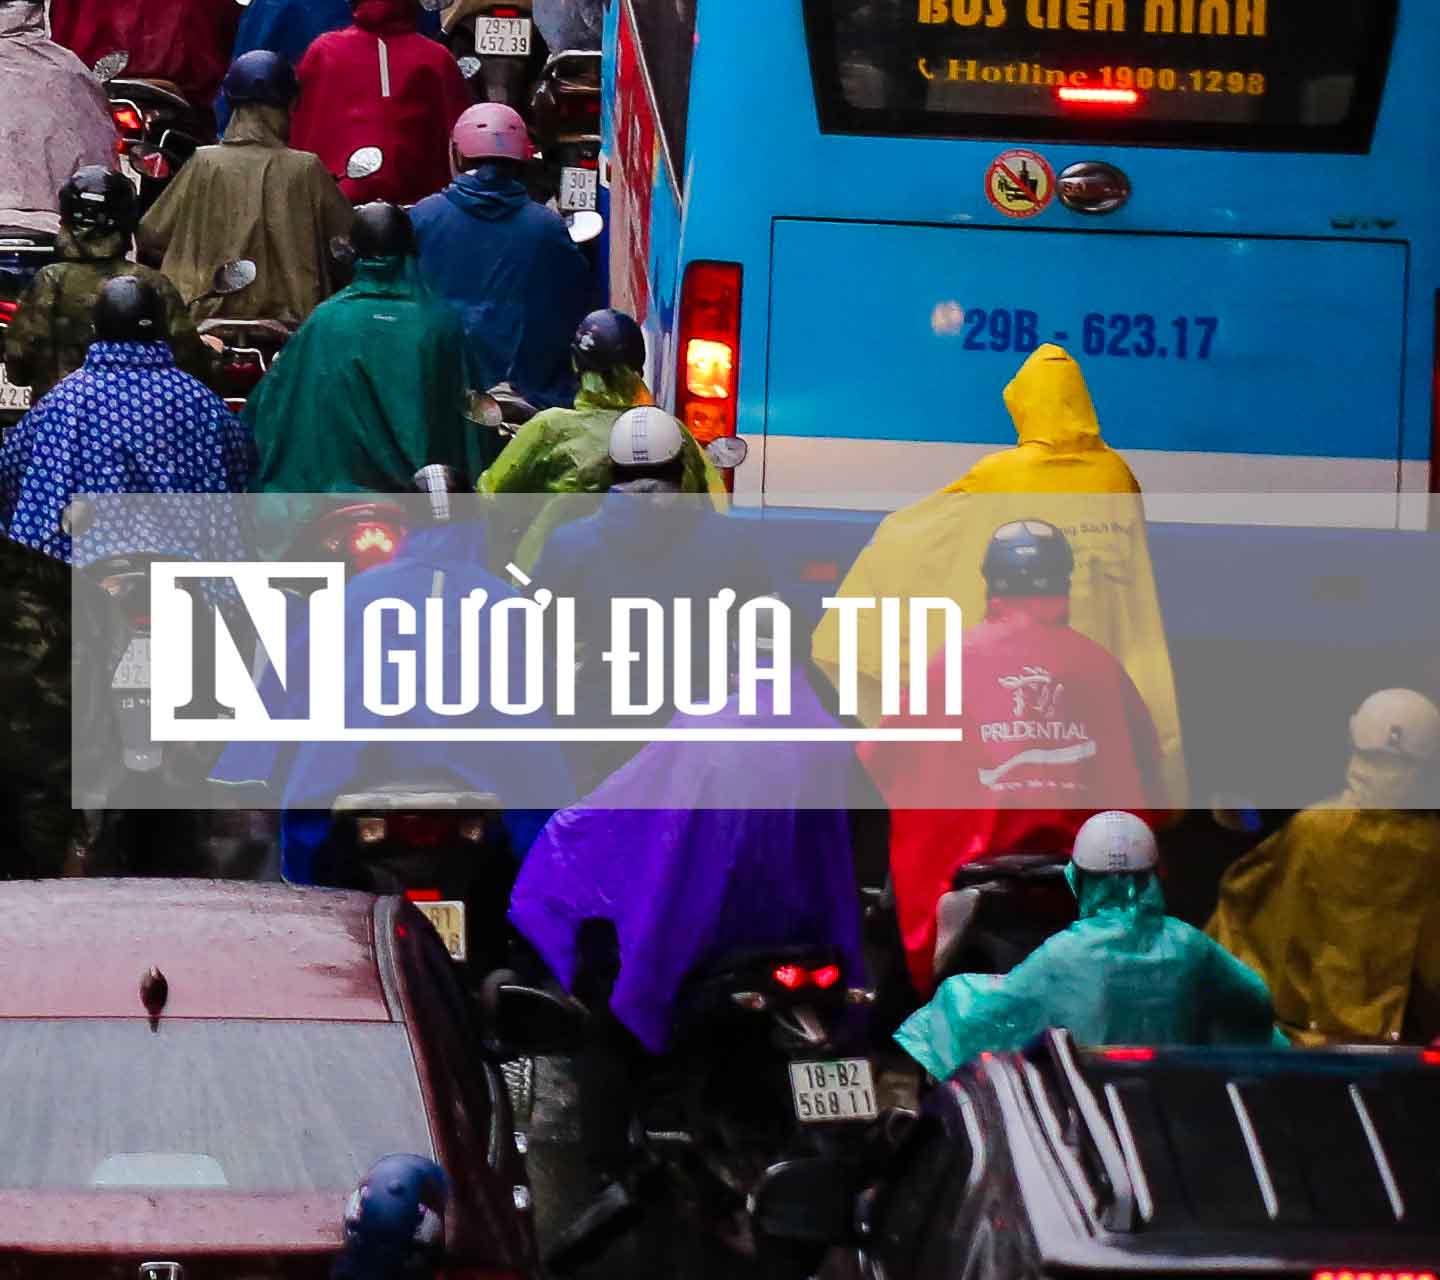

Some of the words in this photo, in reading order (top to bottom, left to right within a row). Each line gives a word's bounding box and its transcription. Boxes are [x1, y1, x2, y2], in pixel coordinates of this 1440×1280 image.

[478, 37, 528, 54] 452.39
[948, 59, 1088, 87] Hotline
[962, 309, 1039, 352] 29B
[1082, 312, 1219, 359] 623.17
[980, 718, 1089, 742] PRUDENTIAL
[805, 1065, 857, 1089] 18-B2
